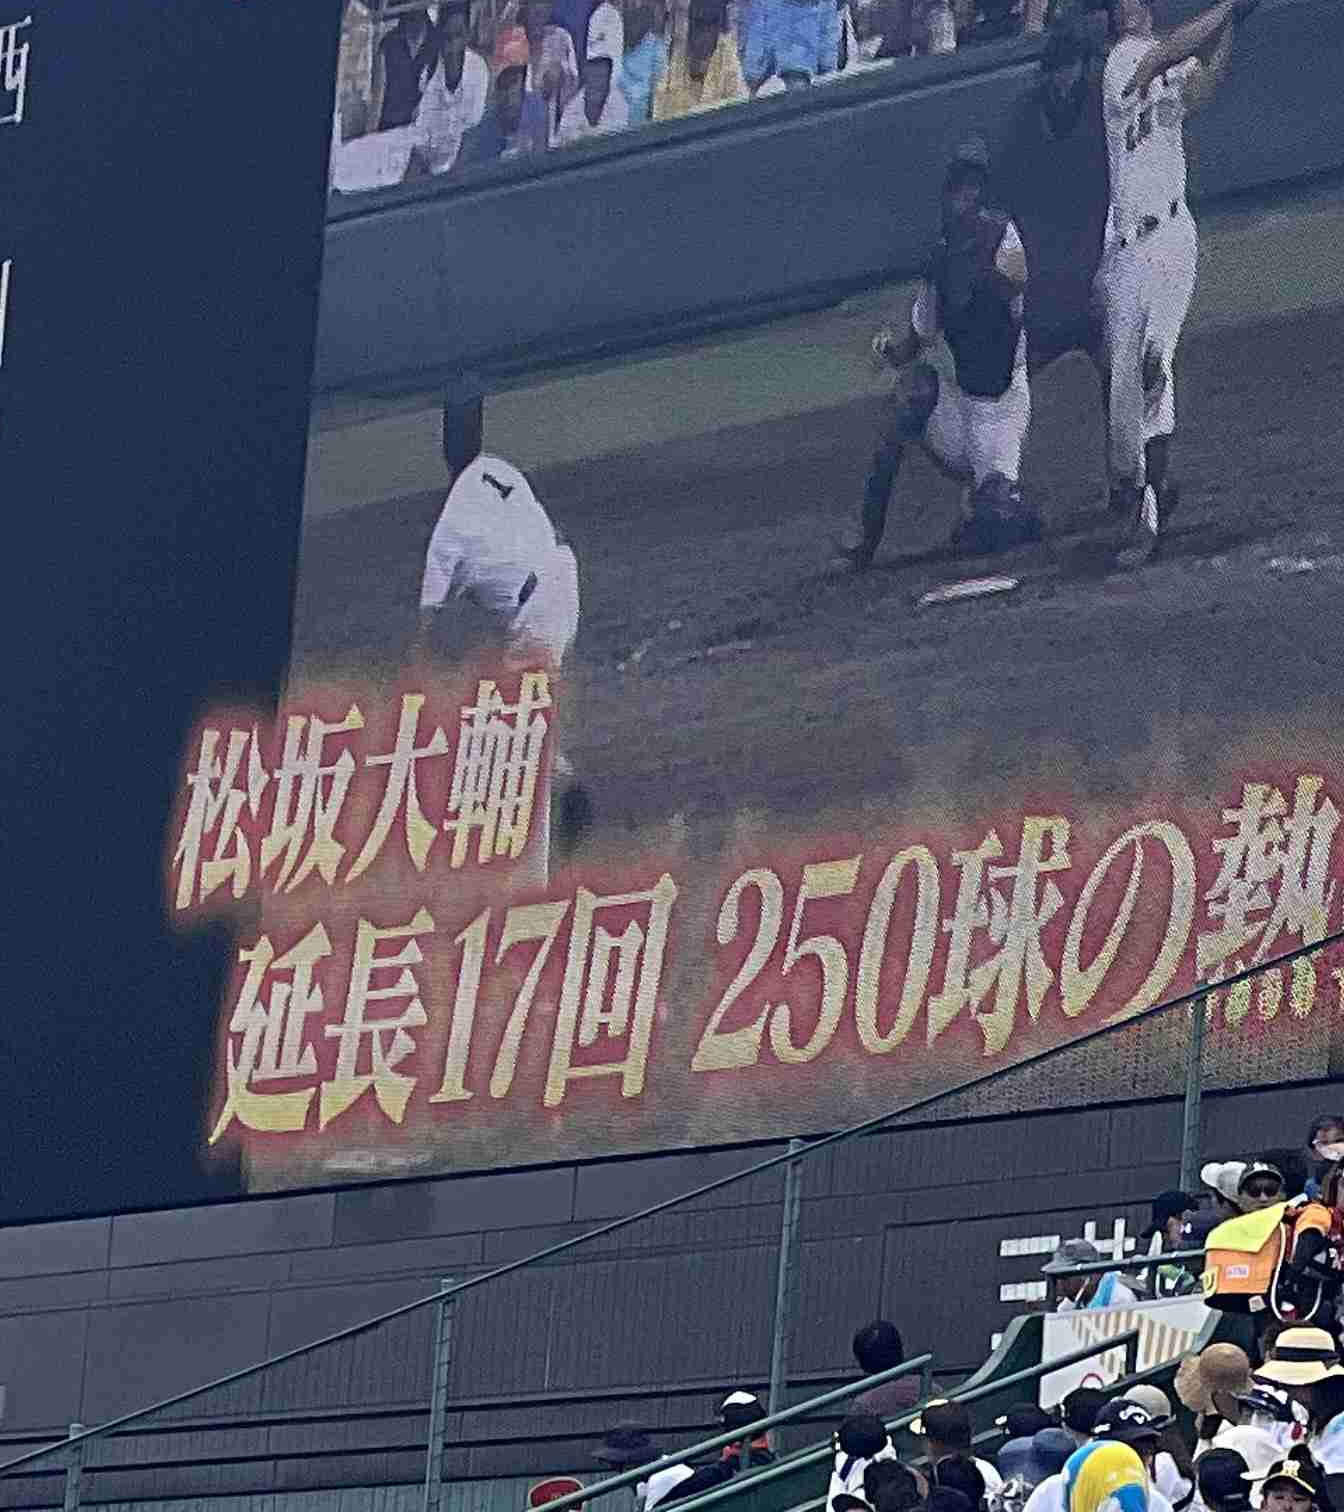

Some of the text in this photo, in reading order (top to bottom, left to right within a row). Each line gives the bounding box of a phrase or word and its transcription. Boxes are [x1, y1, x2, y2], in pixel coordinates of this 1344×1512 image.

[174, 671, 553, 911] 松坂大輔
[208, 872, 679, 1148] 延長17回
